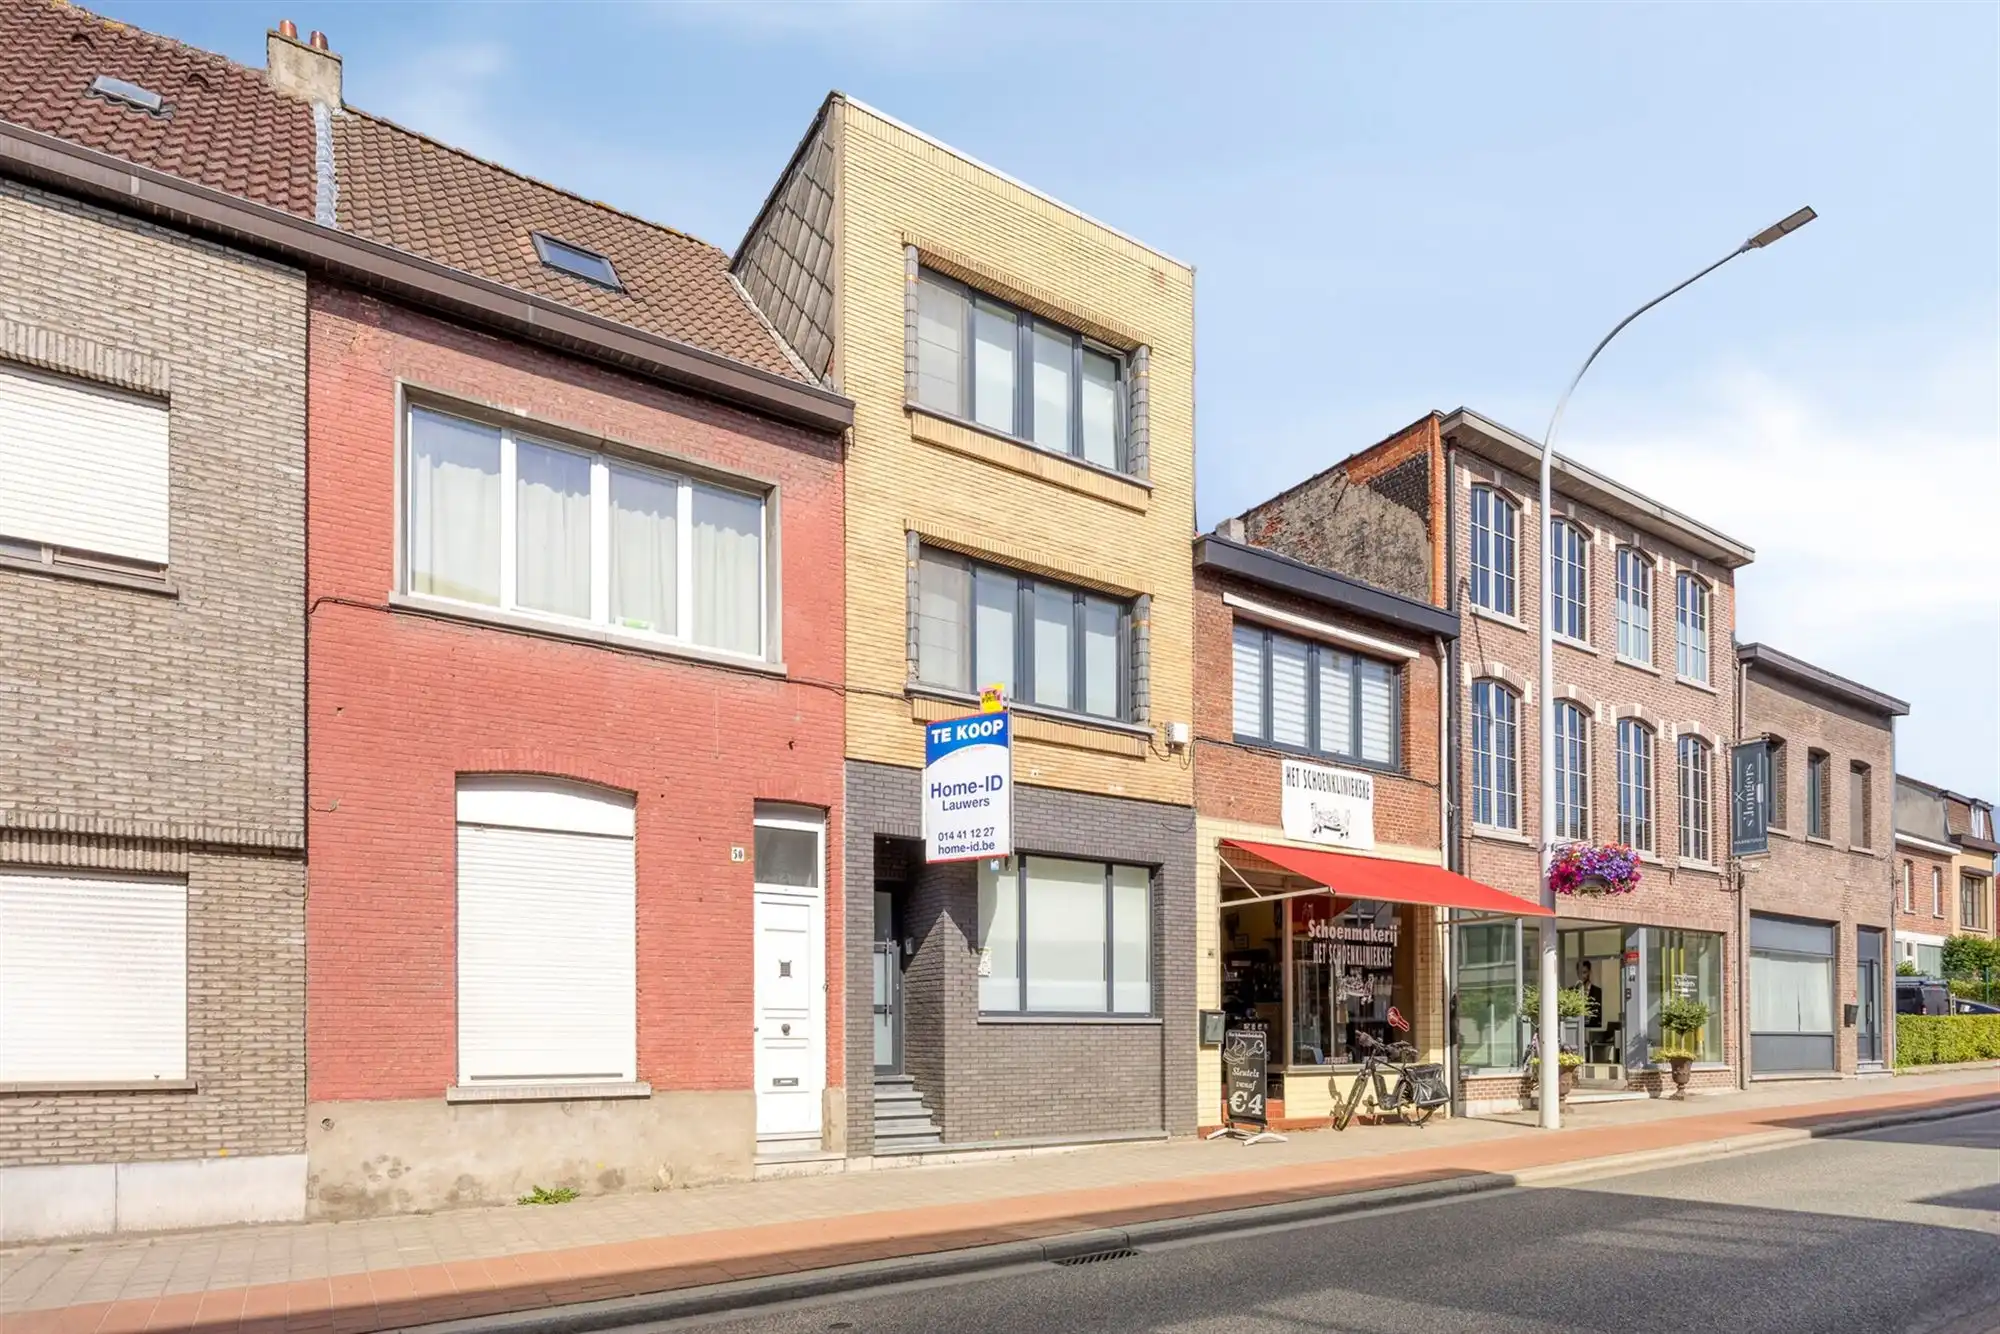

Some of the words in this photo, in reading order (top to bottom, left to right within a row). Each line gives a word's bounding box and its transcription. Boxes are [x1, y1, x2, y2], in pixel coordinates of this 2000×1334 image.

[931, 727, 952, 744] TE
[956, 719, 1004, 741] KOOP
[931, 774, 1003, 799] Home-ID
[1286, 766, 1299, 788] HET
[1303, 768, 1370, 801] SCHOENKLINIEKSKE
[942, 797, 990, 811] Lauwers
[938, 831, 954, 842] 014
[957, 830, 967, 839] 41
[970, 828, 981, 838] 12
[983, 826, 995, 837] 27
[938, 840, 995, 855] home-id.be
[1308, 919, 1397, 947] Schoenmakerij
[1313, 942, 1326, 964] HET
[1232, 1066, 1259, 1078] Sleutels
[1229, 1090, 1263, 1115] €4
